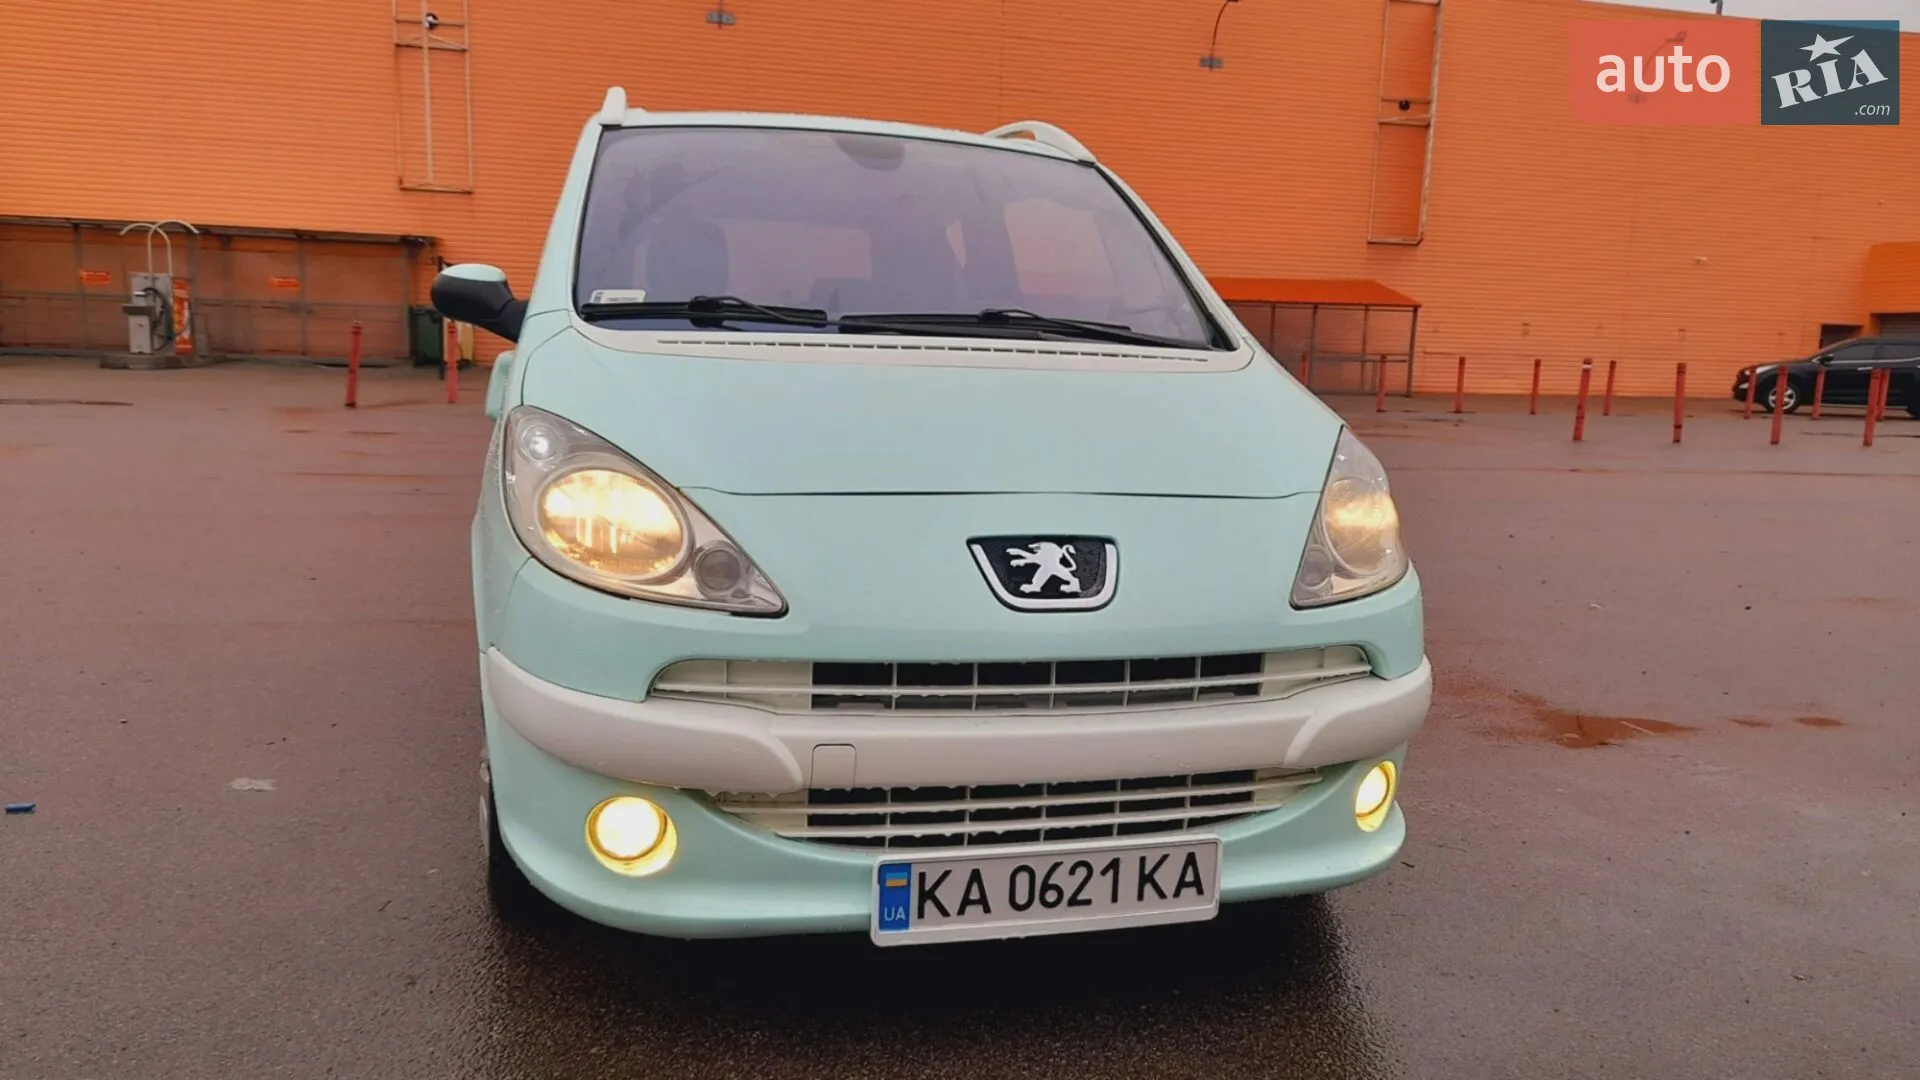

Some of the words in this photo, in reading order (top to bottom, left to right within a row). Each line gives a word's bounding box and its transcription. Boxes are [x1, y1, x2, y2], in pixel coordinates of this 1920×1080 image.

[917, 868, 992, 919] KA
[1008, 857, 1121, 912] 0621
[1137, 851, 1205, 902] KA
[884, 907, 907, 921] UA
